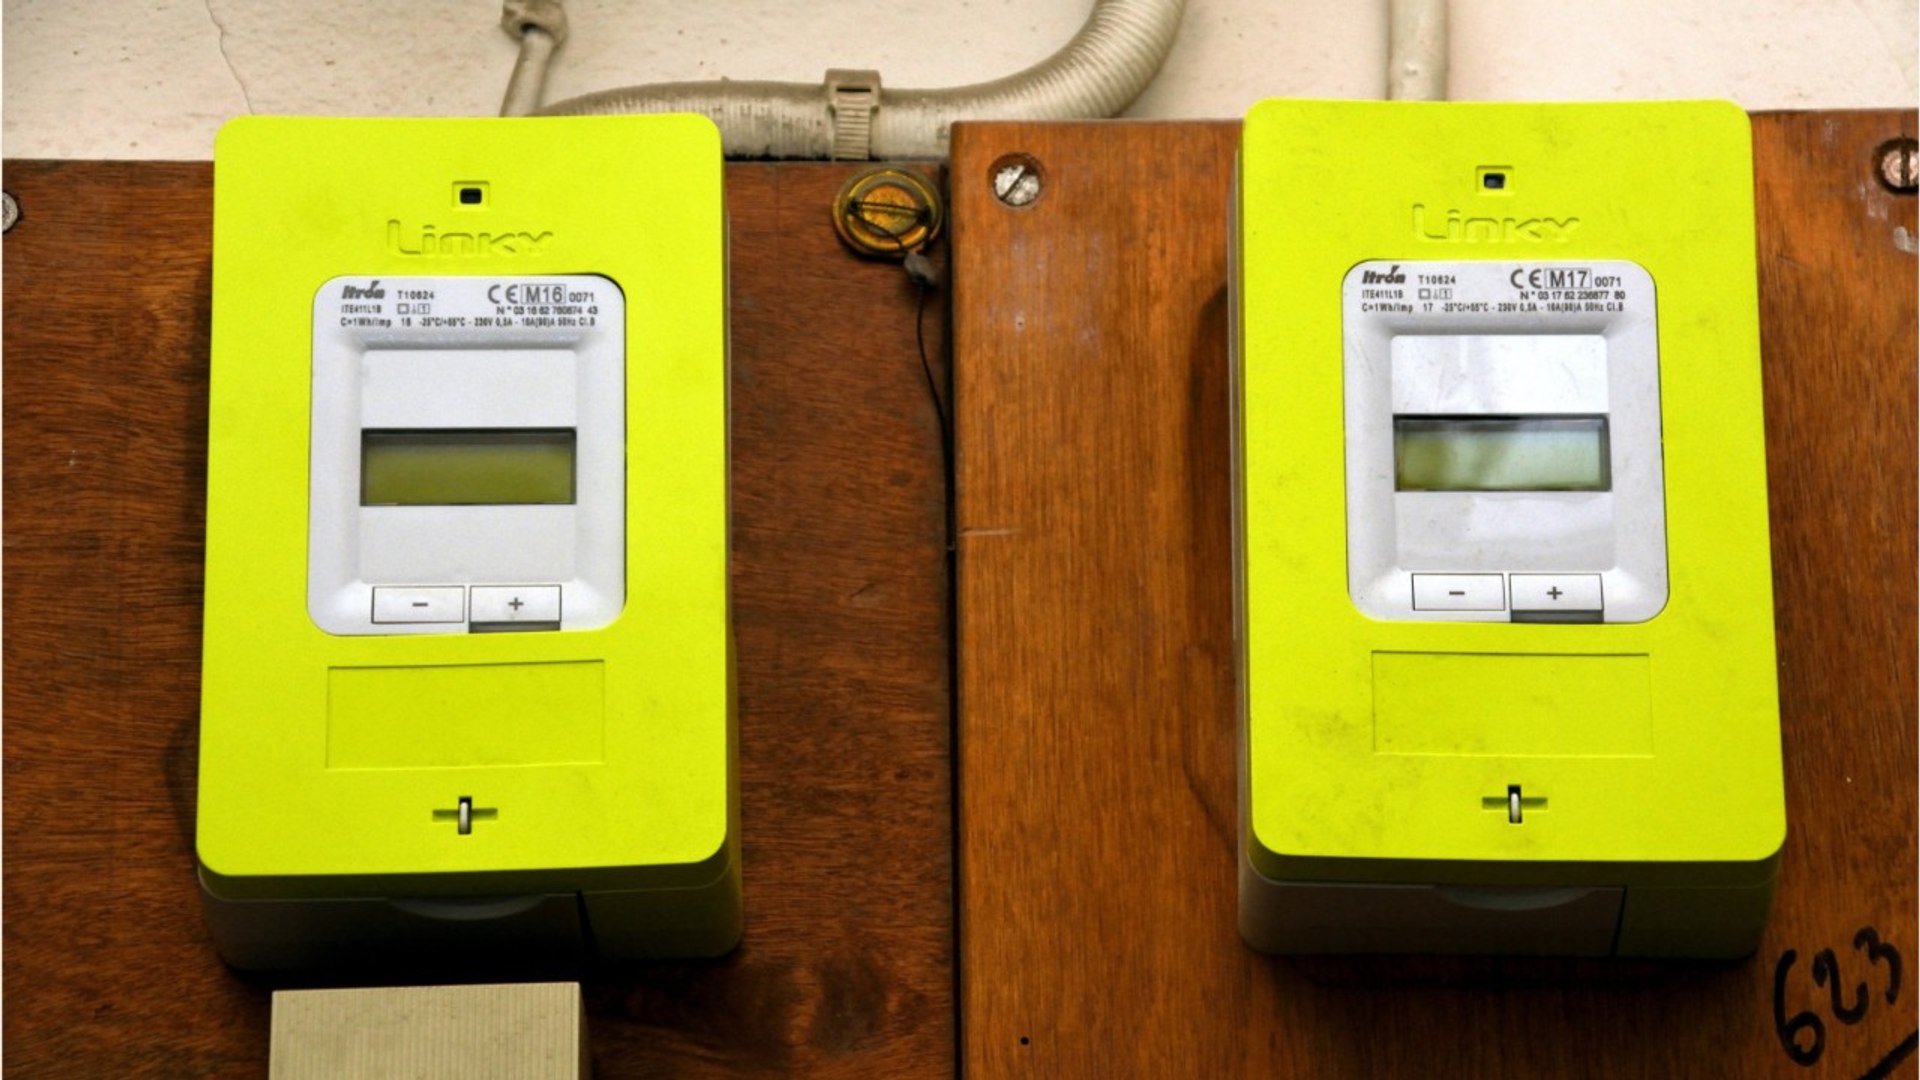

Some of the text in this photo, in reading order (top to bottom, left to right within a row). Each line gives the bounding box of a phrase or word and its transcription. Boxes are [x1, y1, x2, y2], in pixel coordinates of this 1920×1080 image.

[1549, 269, 1588, 288] M17
[1594, 276, 1622, 287] 0071
[525, 286, 564, 303] M16
[568, 292, 595, 303] 0071
[1774, 926, 1902, 1067] 623
